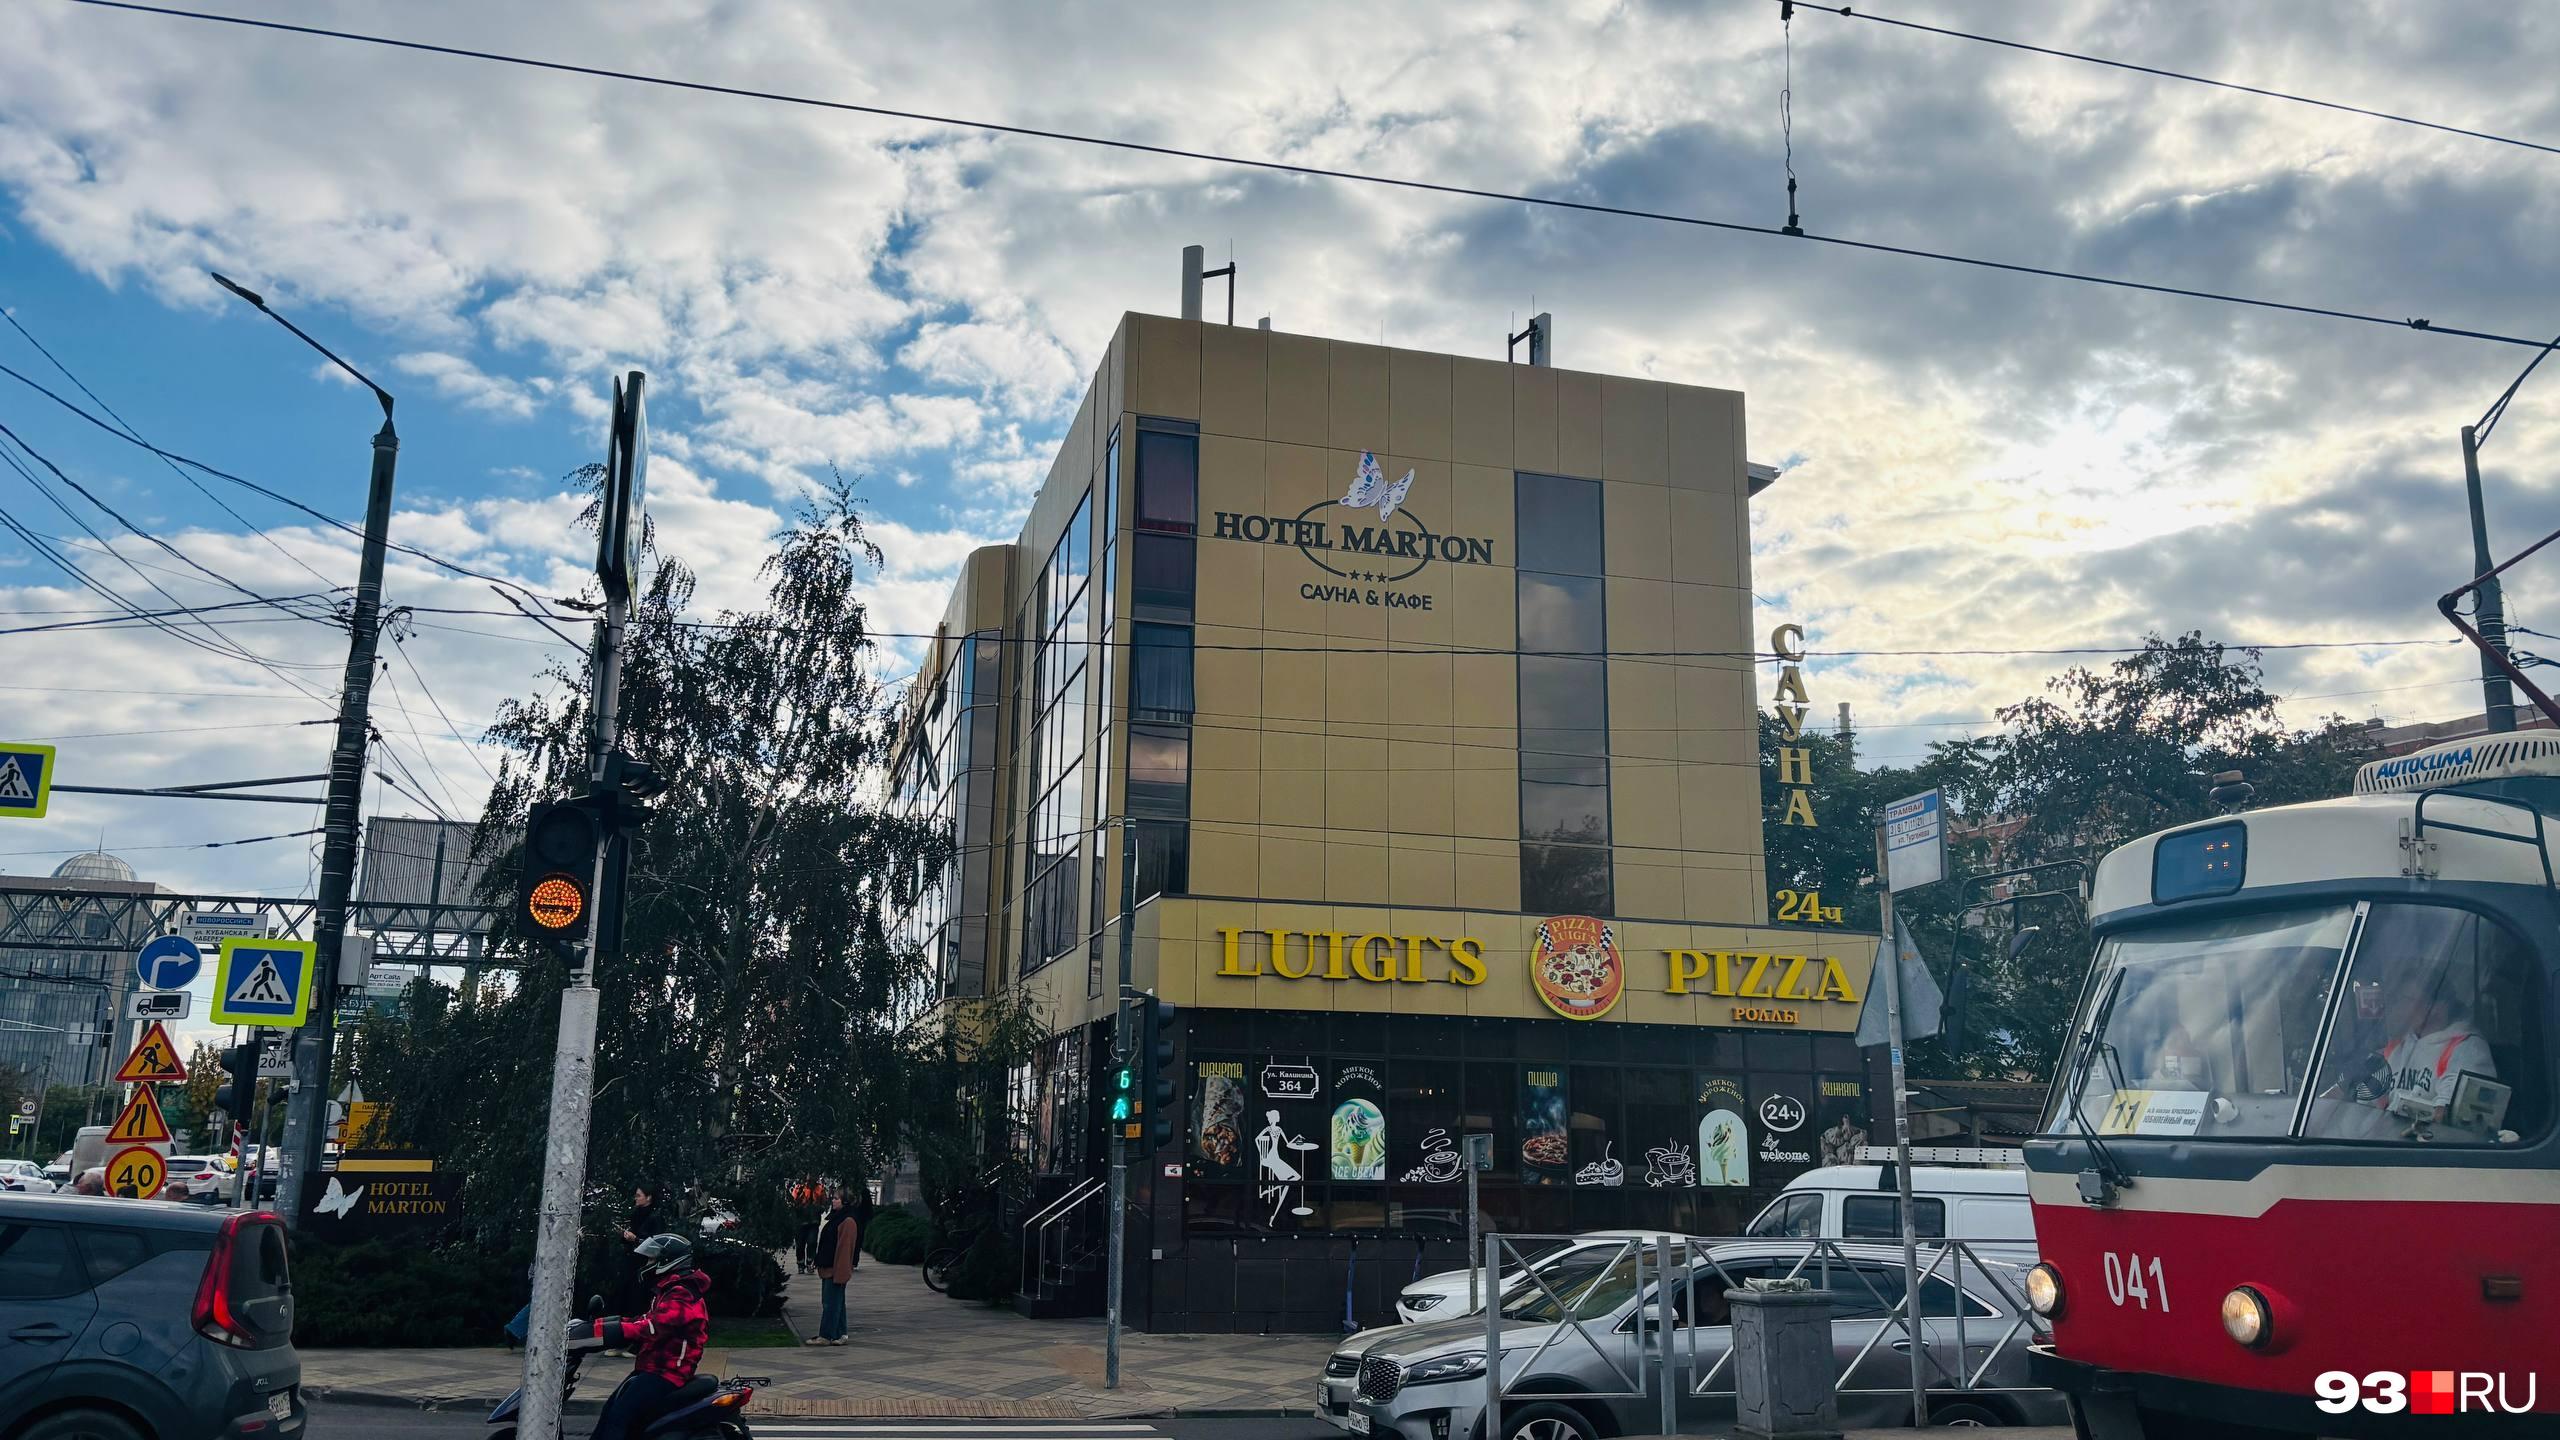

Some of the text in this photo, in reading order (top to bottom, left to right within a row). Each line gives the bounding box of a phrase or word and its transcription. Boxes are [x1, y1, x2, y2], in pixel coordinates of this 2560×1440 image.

[1214, 511, 1493, 564] HOTEL MARTON
[1300, 583, 1432, 610] САУНА & КАФЕ
[1771, 623, 1818, 827] САУНА
[2376, 747, 2473, 779] AUTOCLIMA
[1775, 889, 1843, 923] 24ч
[206, 929, 248, 937] КУБАНСКАЯ
[1551, 918, 1597, 934] PIZZA
[1663, 950, 1859, 1003] PIZZA
[1732, 1007, 1800, 1024] РОЛЛЫ
[1199, 1062, 1243, 1078] ШАУРМА
[1267, 1071, 1313, 1079] ул. Калинина
[1342, 1065, 1375, 1076] МЯГКОЕ
[1120, 1070, 1129, 1088] 6
[1278, 1081, 1302, 1092] 364
[1335, 1072, 1383, 1091] МОРОЖЕНОЕ
[1528, 1071, 1558, 1087] ПИЦЦА
[1705, 1079, 1738, 1089] МЯГКОЕ
[1698, 1086, 1745, 1105] МОРОЖЕНОЕ
[1822, 1081, 1861, 1097] ХИНКАЛИ
[1766, 1104, 1800, 1121] 24ч
[2111, 1100, 2141, 1129] 11
[1760, 1149, 1810, 1162] welcome
[116, 1164, 154, 1188] 40
[369, 1182, 432, 1196] HOTEL
[368, 1200, 446, 1214] MARTON
[2104, 1251, 2169, 1312] 041
